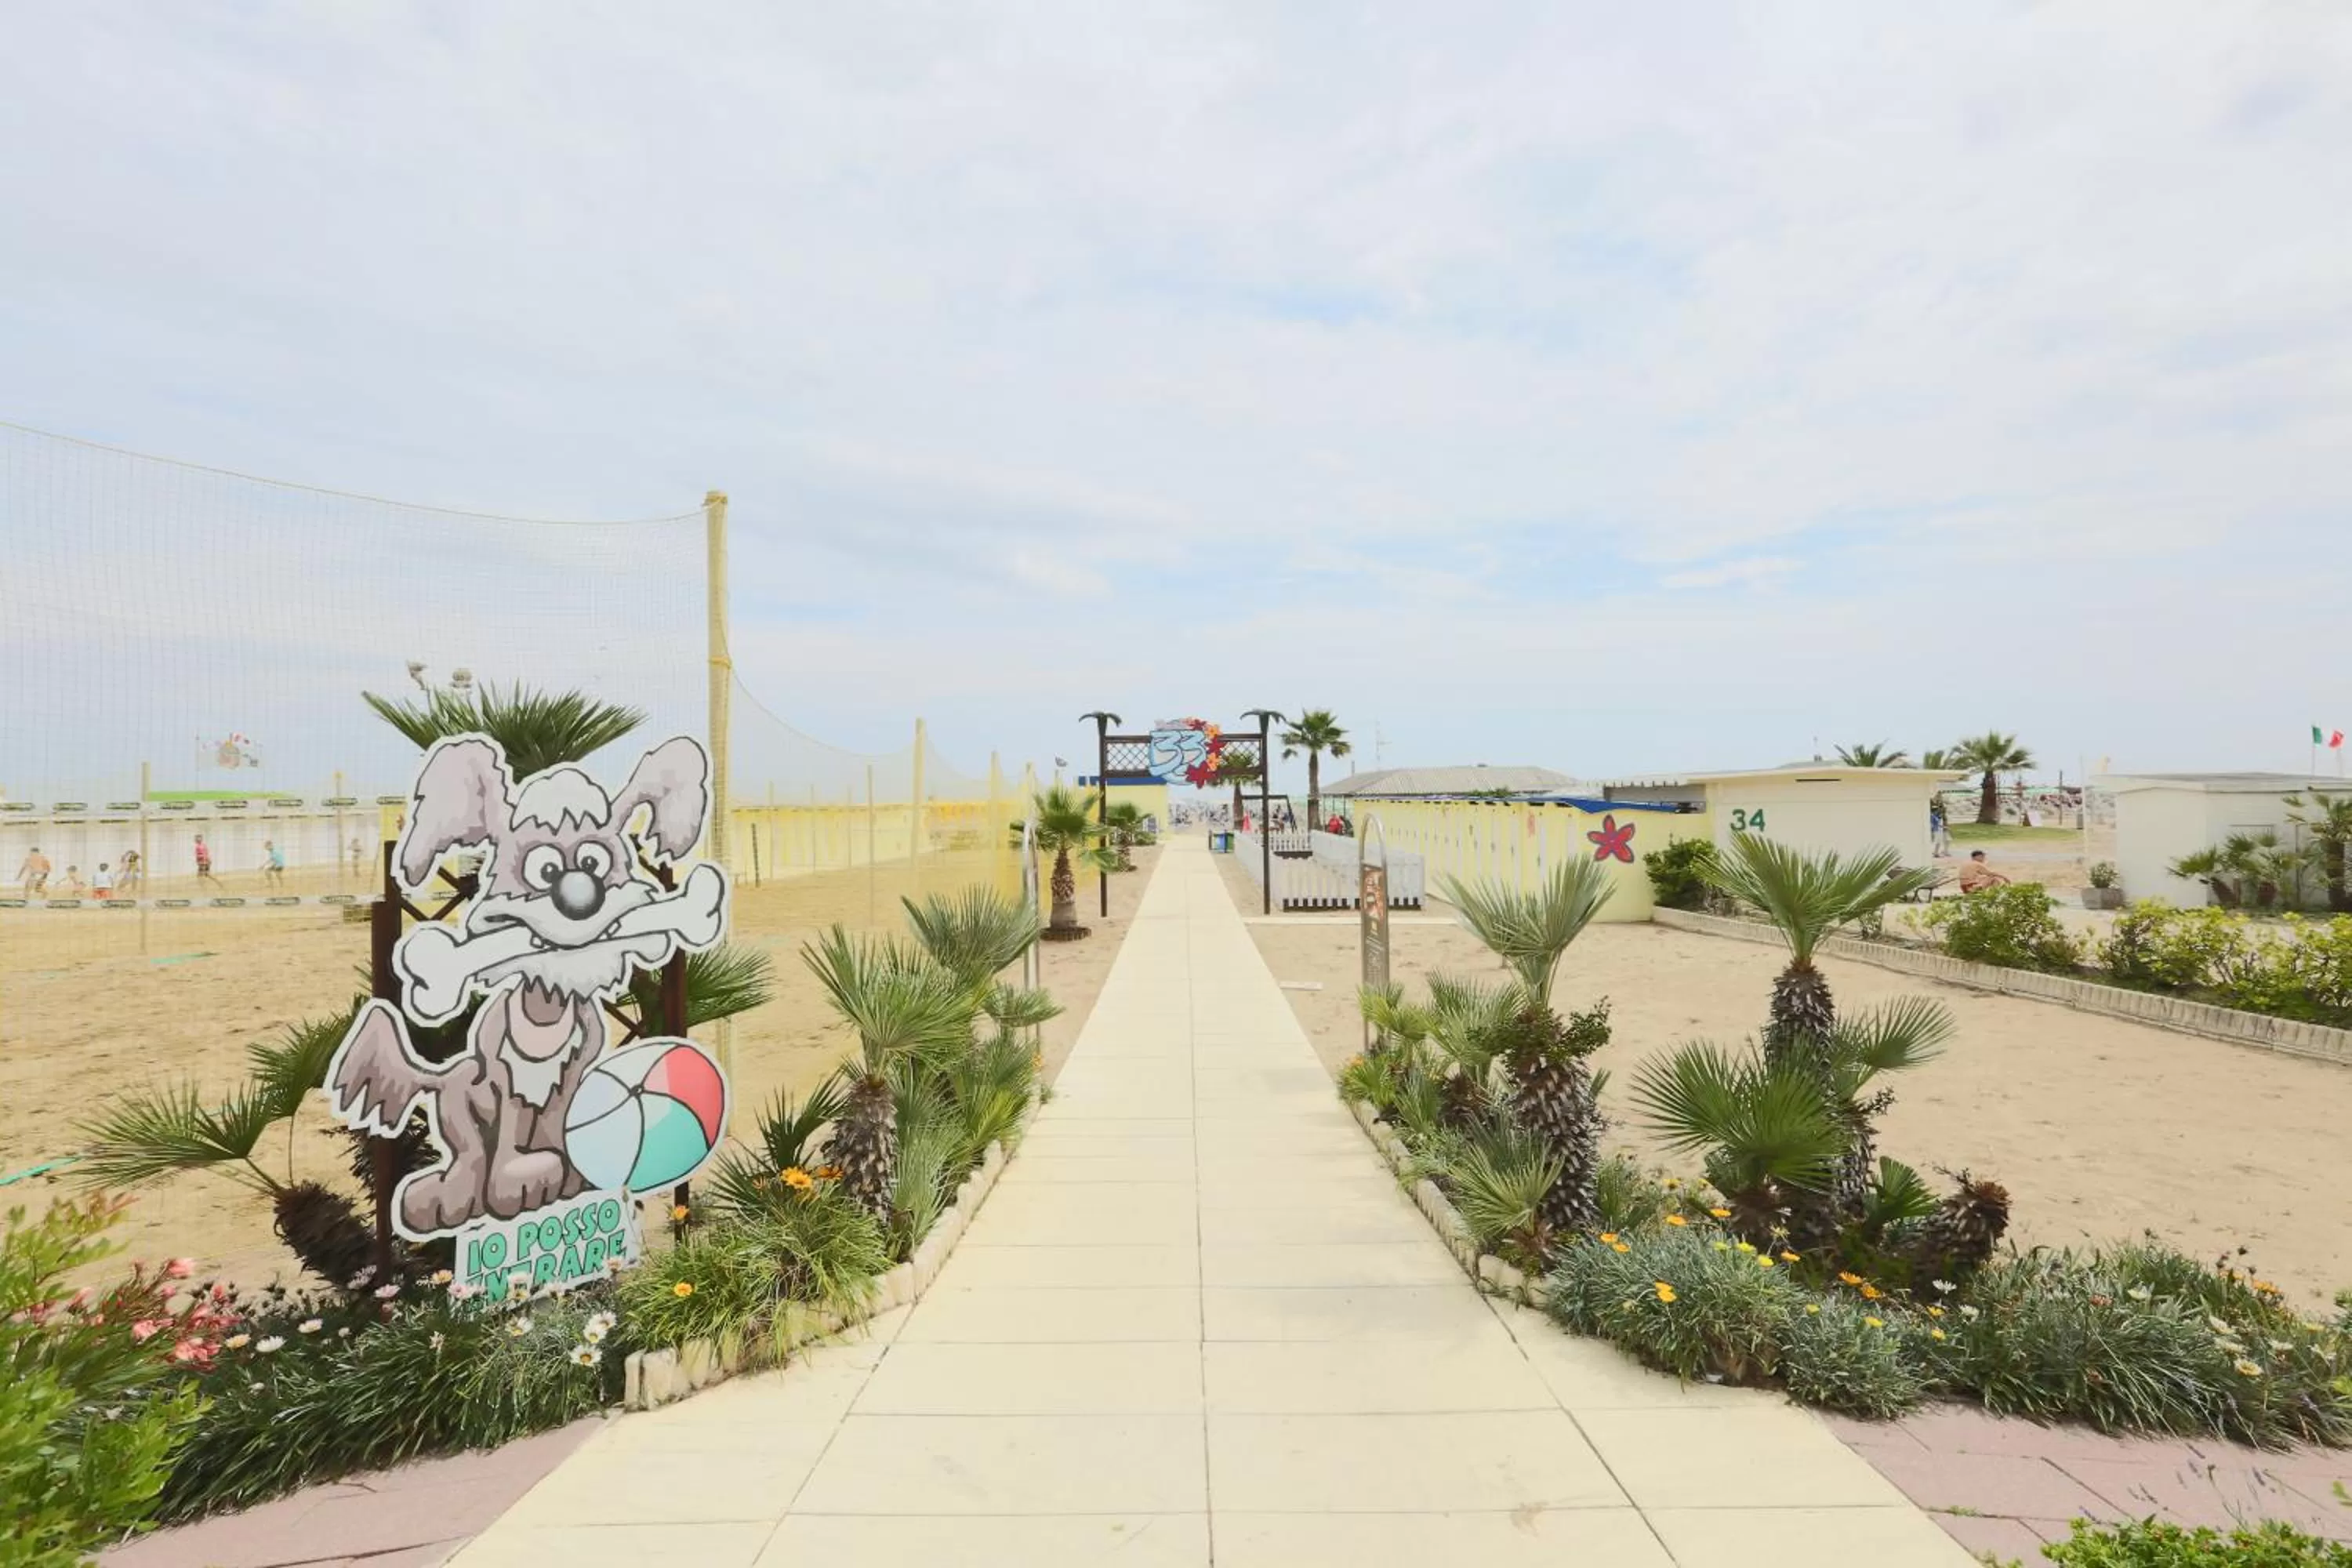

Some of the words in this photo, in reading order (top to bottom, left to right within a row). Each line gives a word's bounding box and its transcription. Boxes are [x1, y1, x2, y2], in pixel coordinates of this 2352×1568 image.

[1730, 808, 1766, 832] 34
[468, 1232, 507, 1276] IO
[517, 1199, 620, 1261] POSSO
